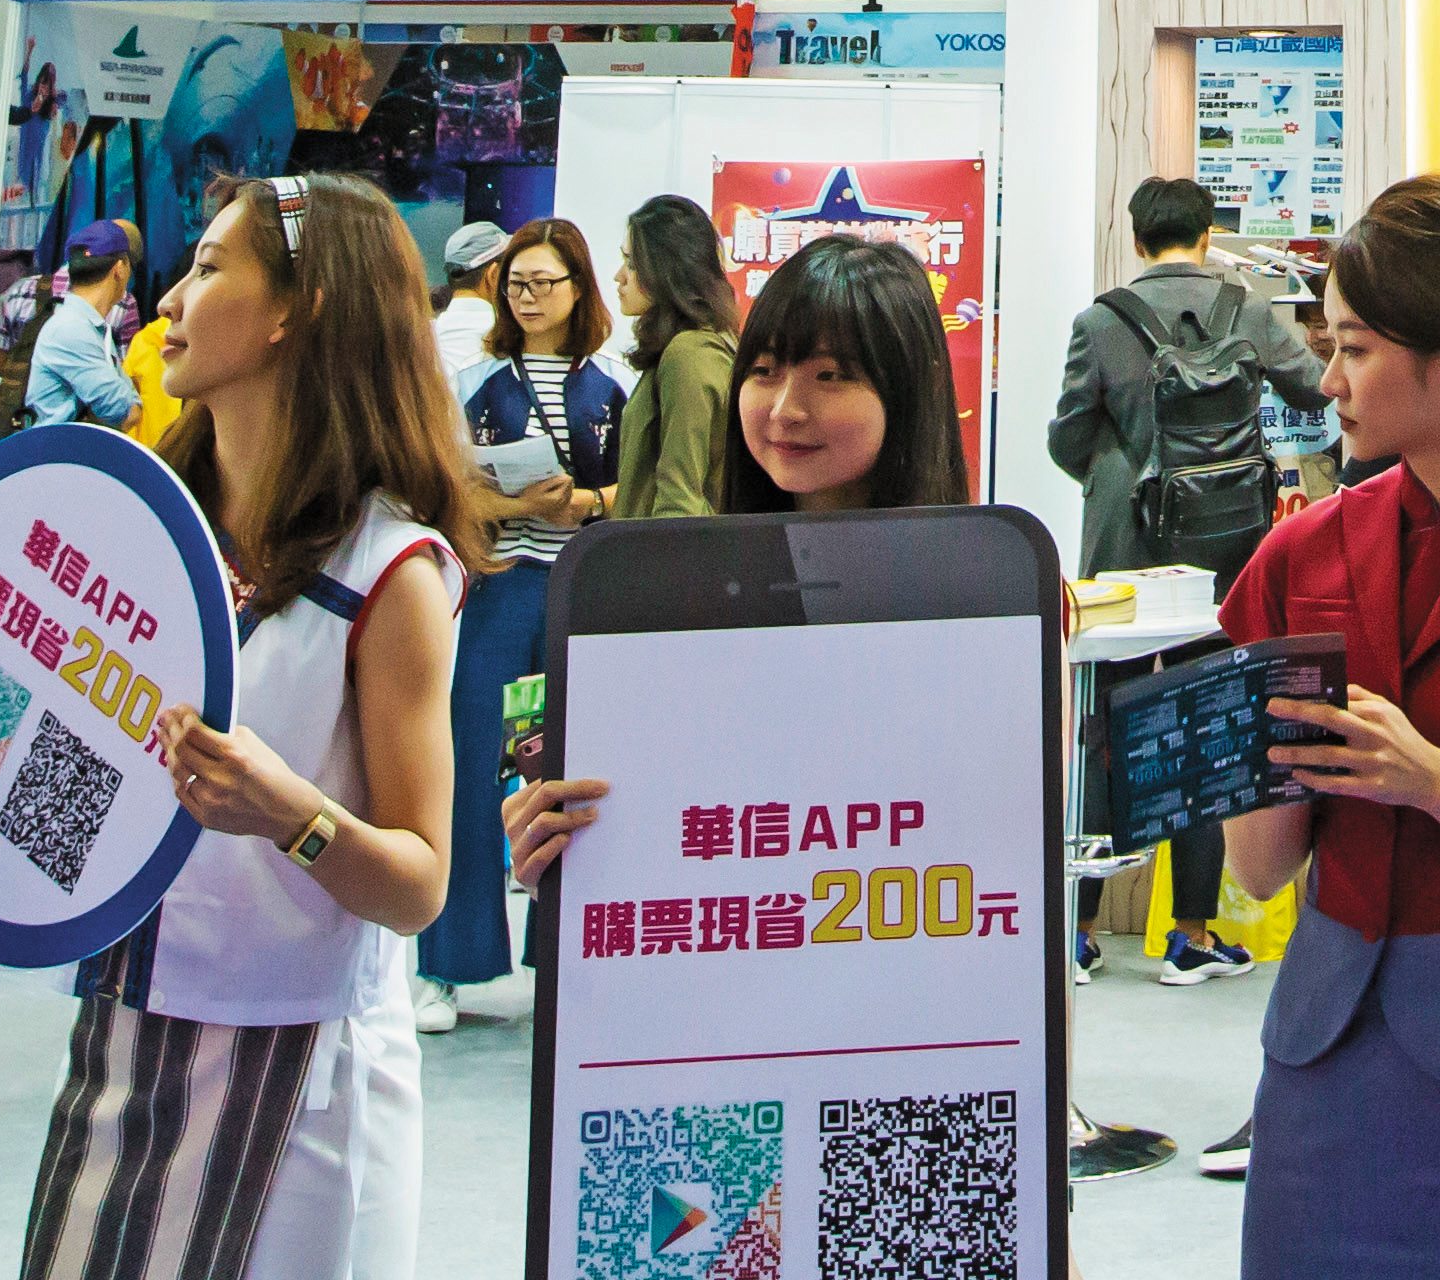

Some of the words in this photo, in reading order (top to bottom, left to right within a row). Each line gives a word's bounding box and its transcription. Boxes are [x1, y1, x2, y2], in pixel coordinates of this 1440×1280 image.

[775, 28, 883, 66] Travel
[22, 519, 159, 645] 華信APP
[681, 800, 926, 861] 華信APP
[582, 863, 1022, 961] 購票現省200元
